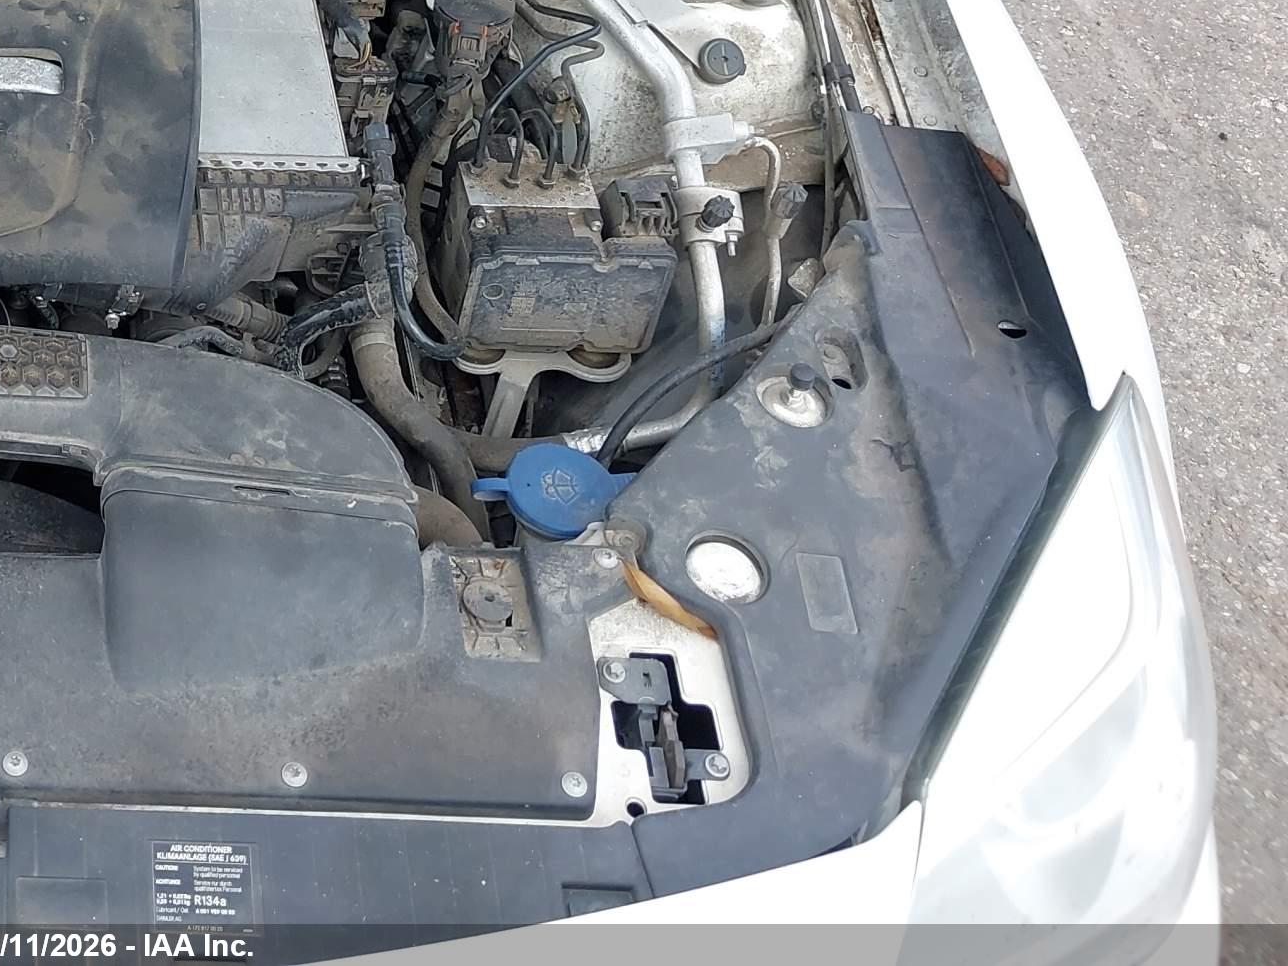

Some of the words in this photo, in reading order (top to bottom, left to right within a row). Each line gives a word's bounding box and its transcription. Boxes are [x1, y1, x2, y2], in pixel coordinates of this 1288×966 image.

[170, 844, 183, 852] AIR
[183, 845, 233, 854] CONDITIONER
[156, 852, 207, 861] KLIMAANLAGE
[208, 854, 224, 863] (SAE
[194, 894, 227, 906] R134a
